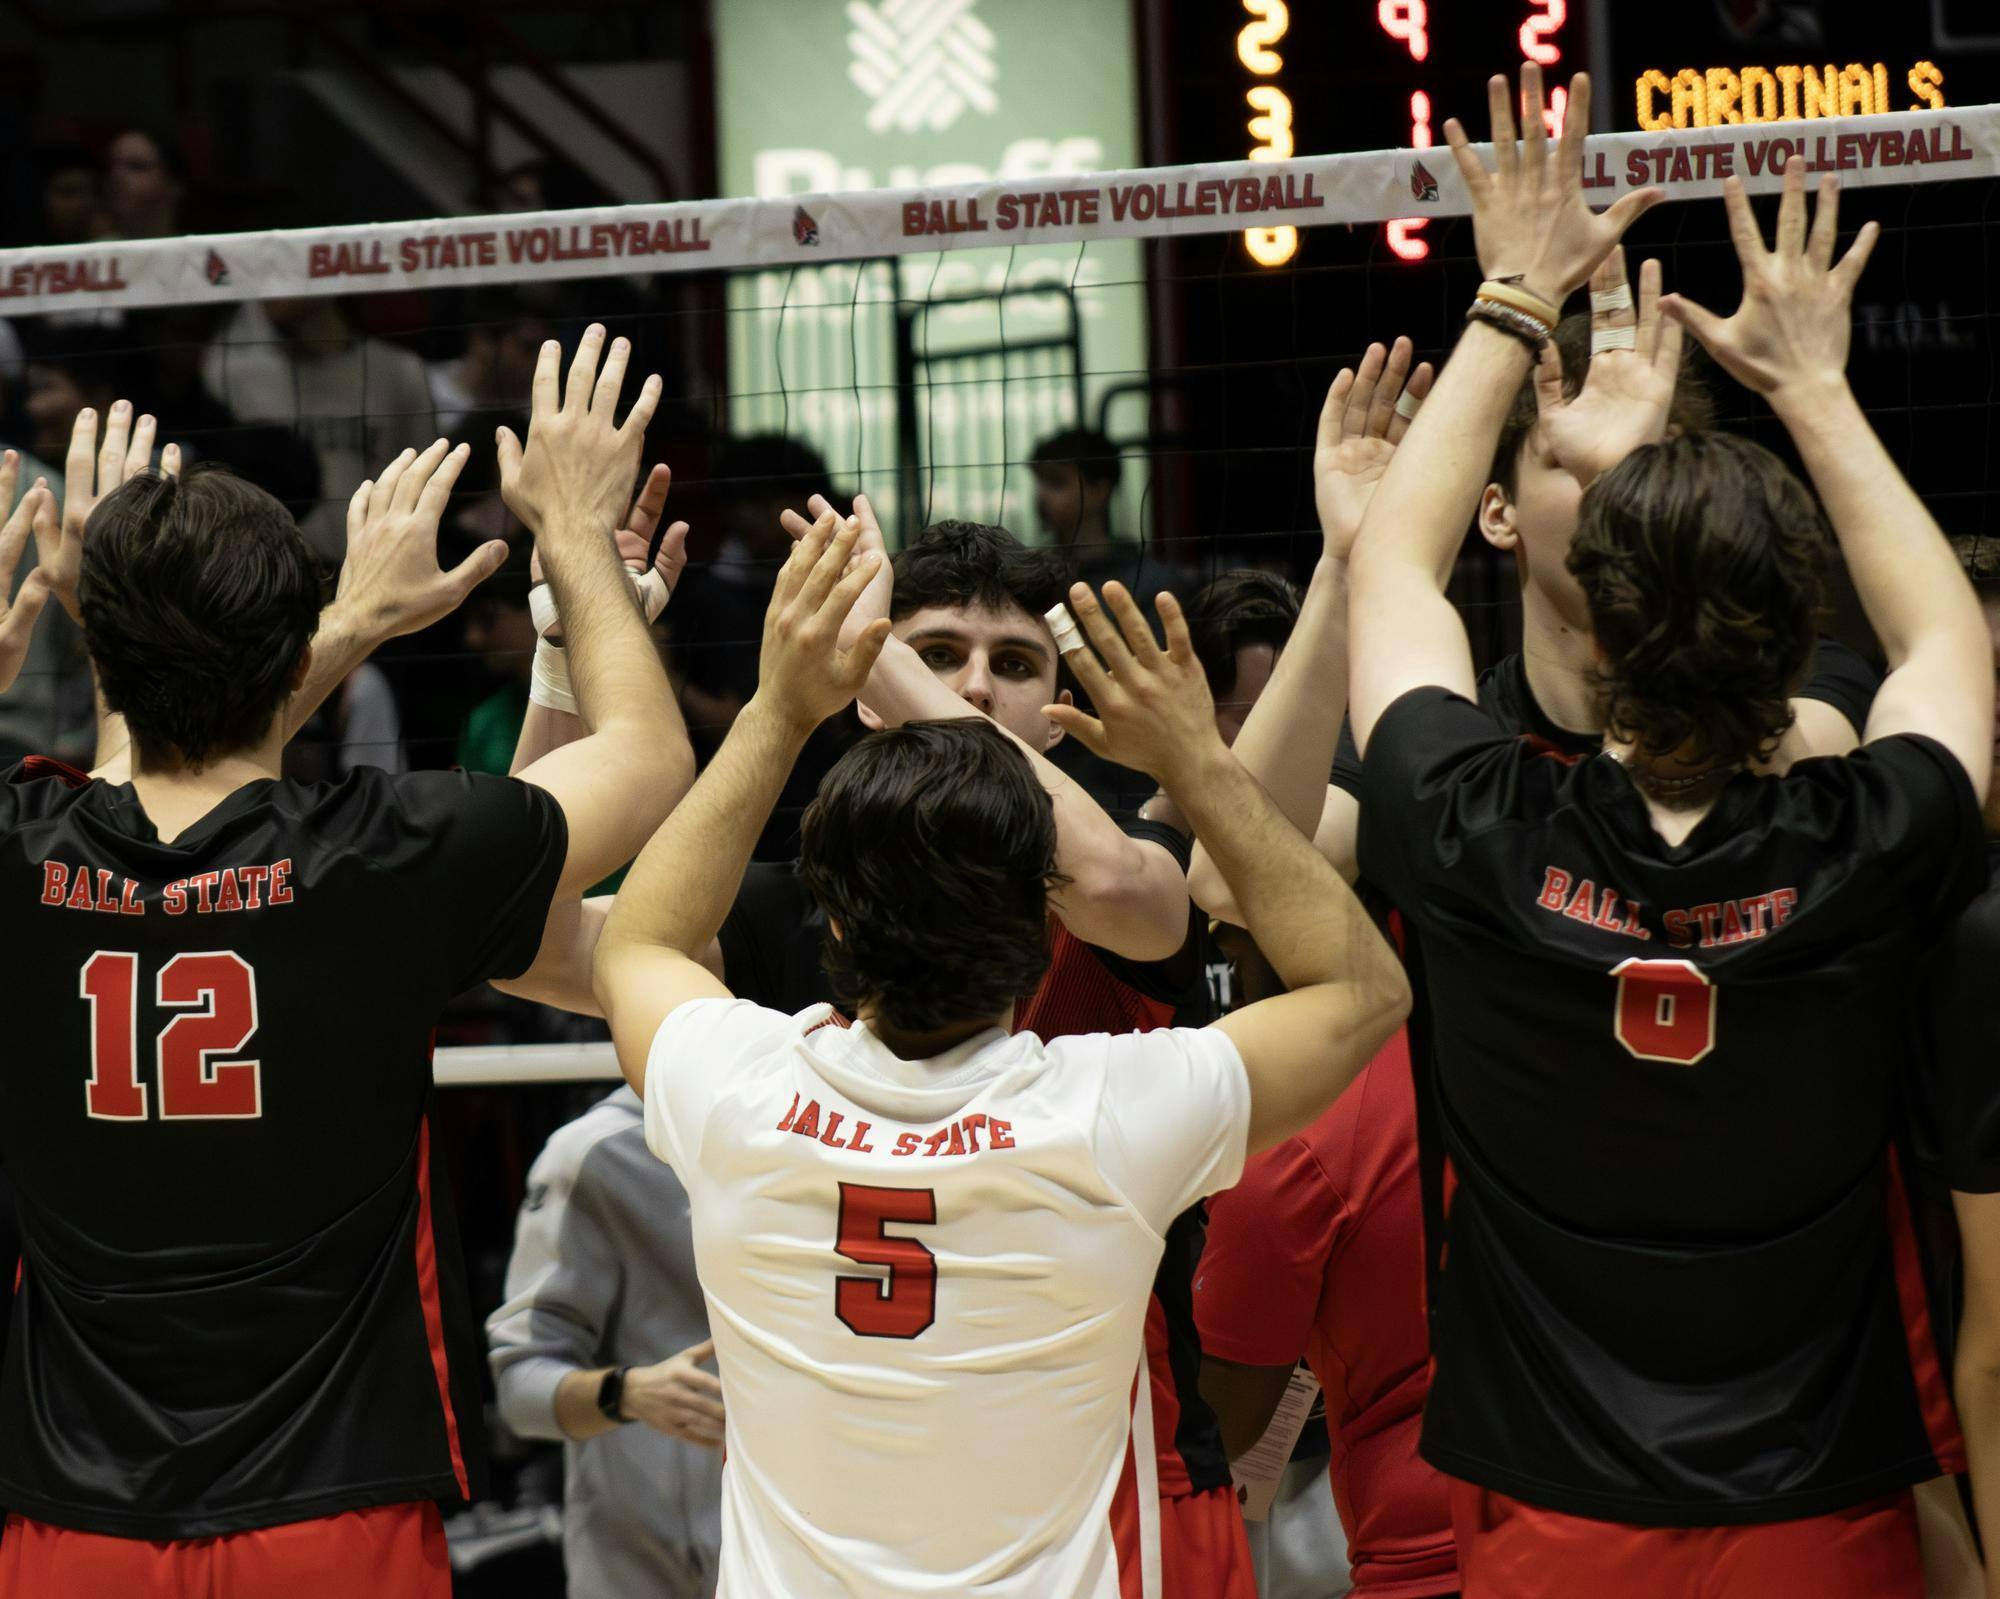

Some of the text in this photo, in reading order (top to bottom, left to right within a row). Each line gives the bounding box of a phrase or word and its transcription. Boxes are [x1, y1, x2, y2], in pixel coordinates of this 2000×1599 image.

[1626, 143, 1735, 186] STATE
[902, 173, 1324, 236] BALL STATE VOLLEYBALL
[308, 217, 711, 279] BALL STATE VOLLEYBALL
[41, 857, 294, 915] BALL STATE
[1536, 865, 1798, 949] BALL STATE
[80, 950, 262, 1121] 12
[891, 1112, 1016, 1157] STATE
[833, 1181, 937, 1341] 5
